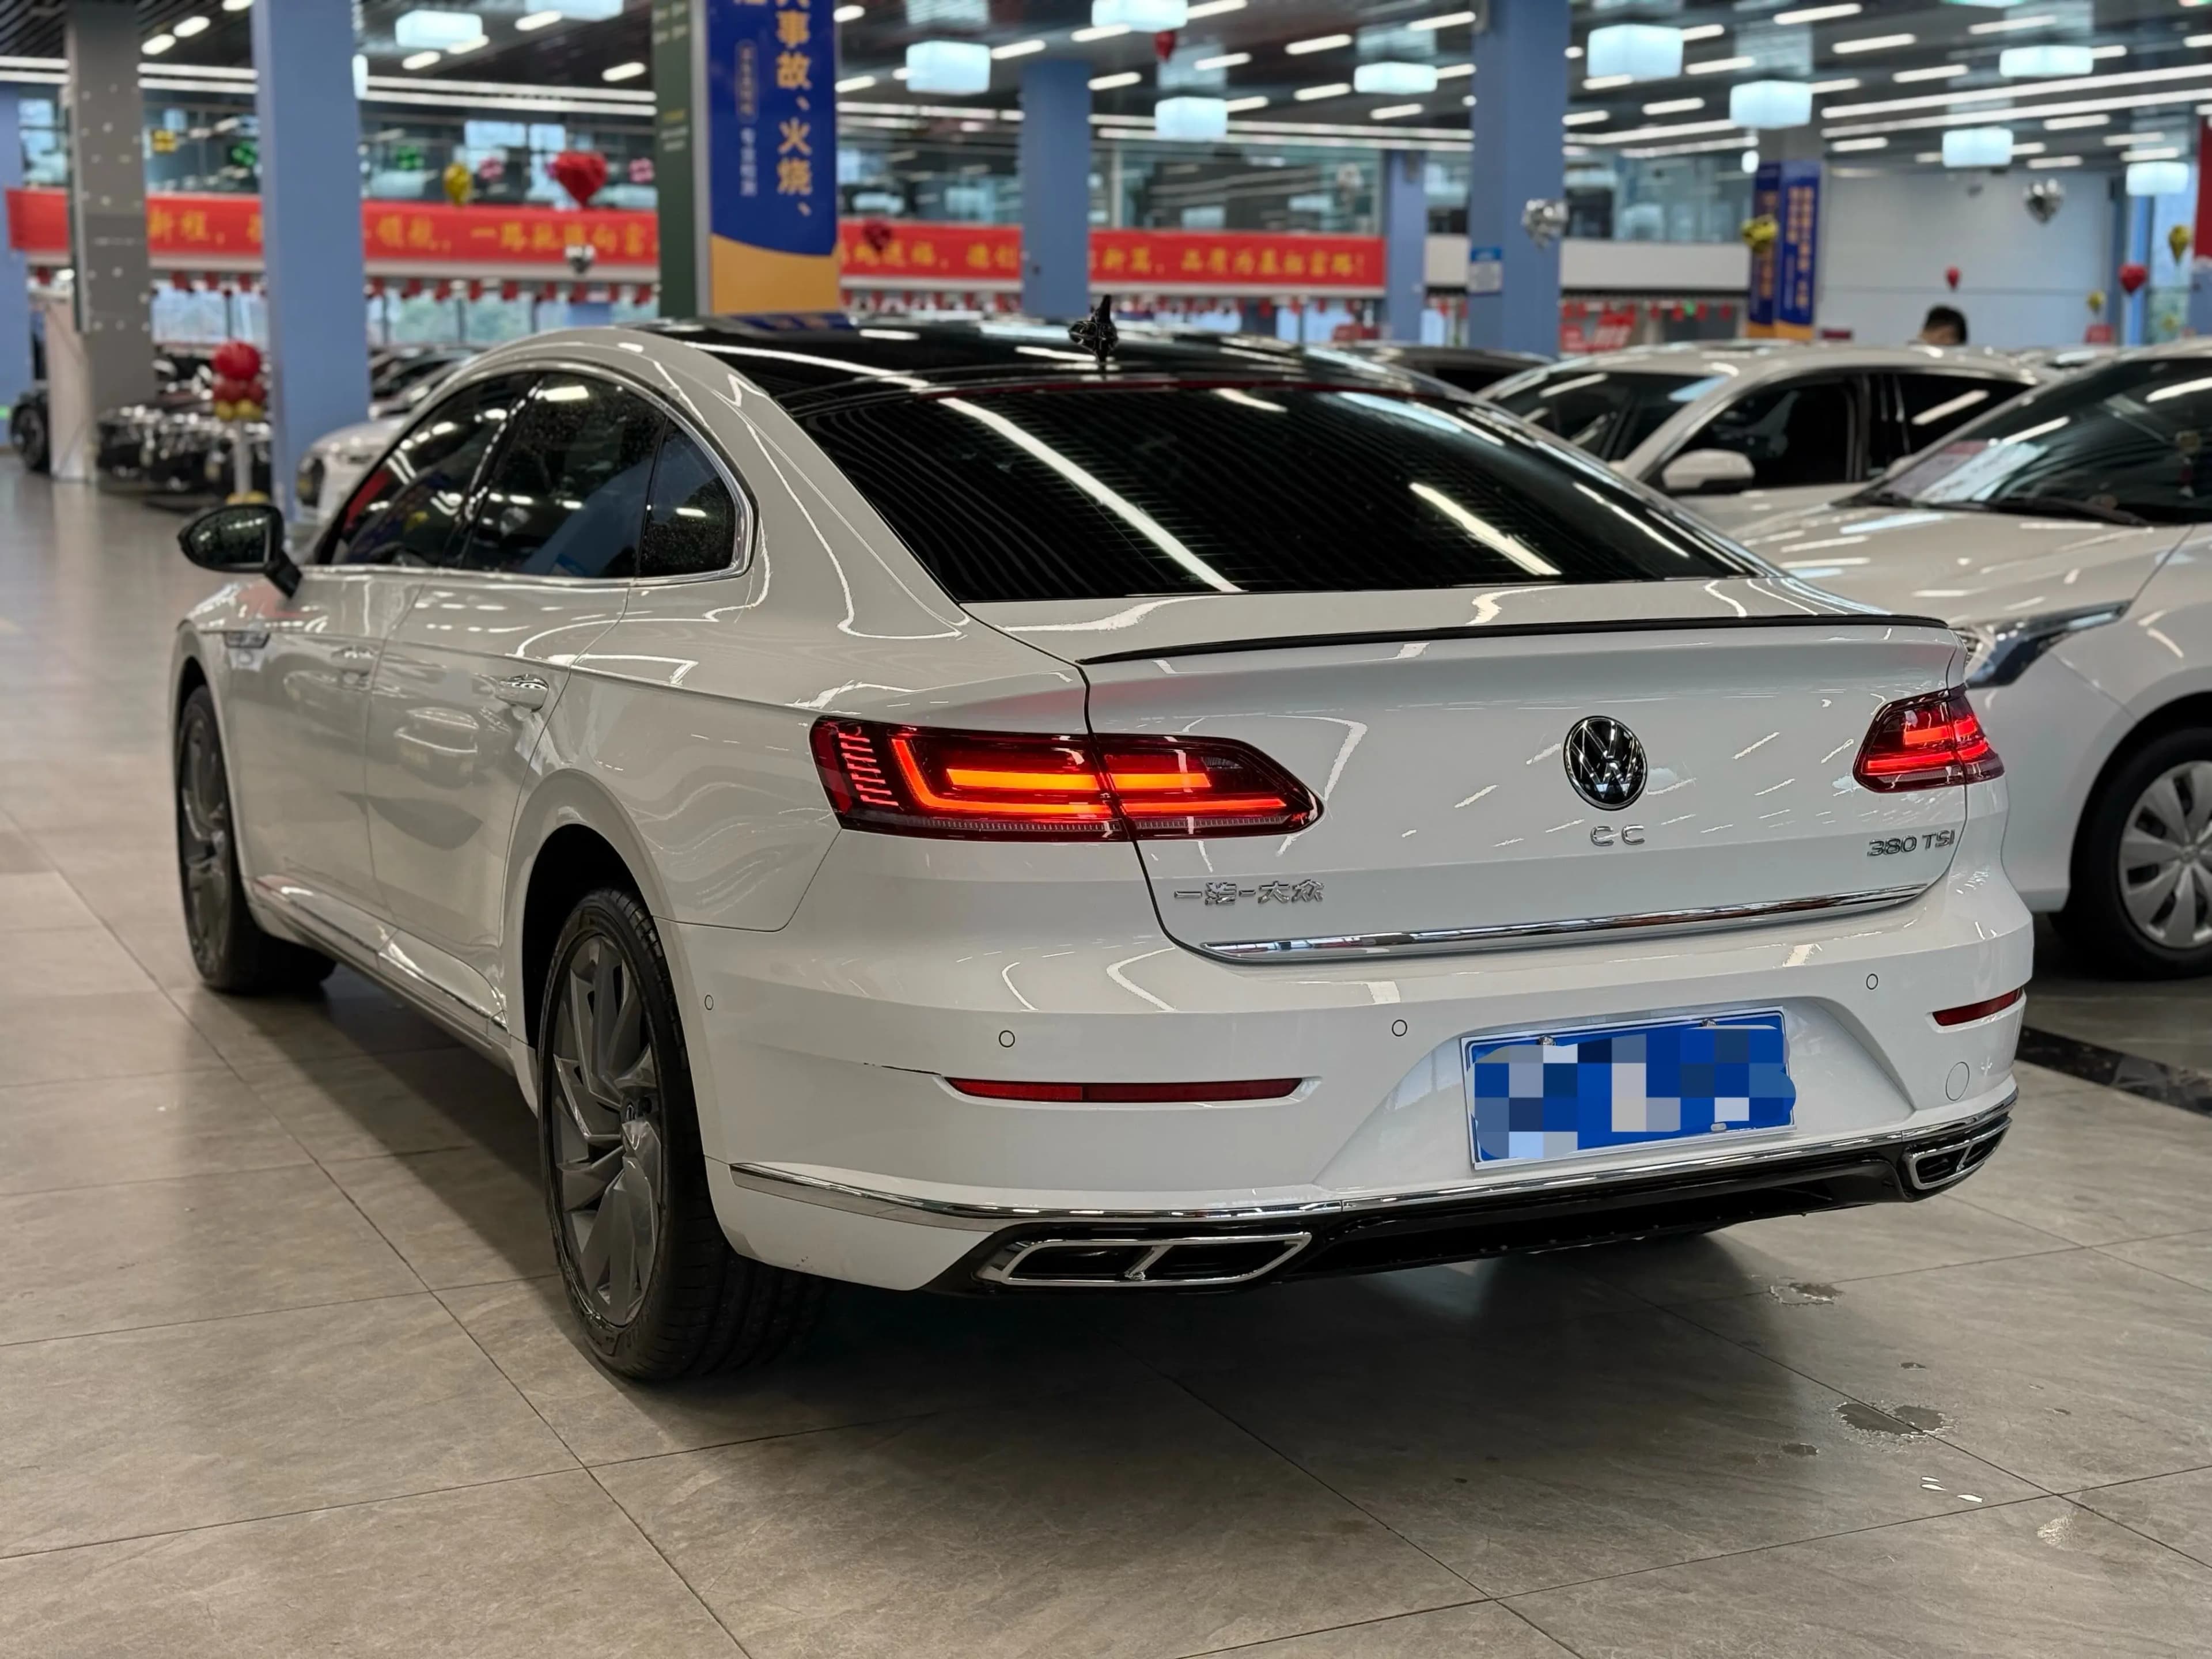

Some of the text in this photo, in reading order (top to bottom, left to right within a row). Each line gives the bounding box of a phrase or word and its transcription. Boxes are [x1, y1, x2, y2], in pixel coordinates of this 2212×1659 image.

[775, 0, 812, 216] 事故、火烧、
[1590, 824, 1645, 846] CC
[1867, 830, 1955, 857] 380 TSI
